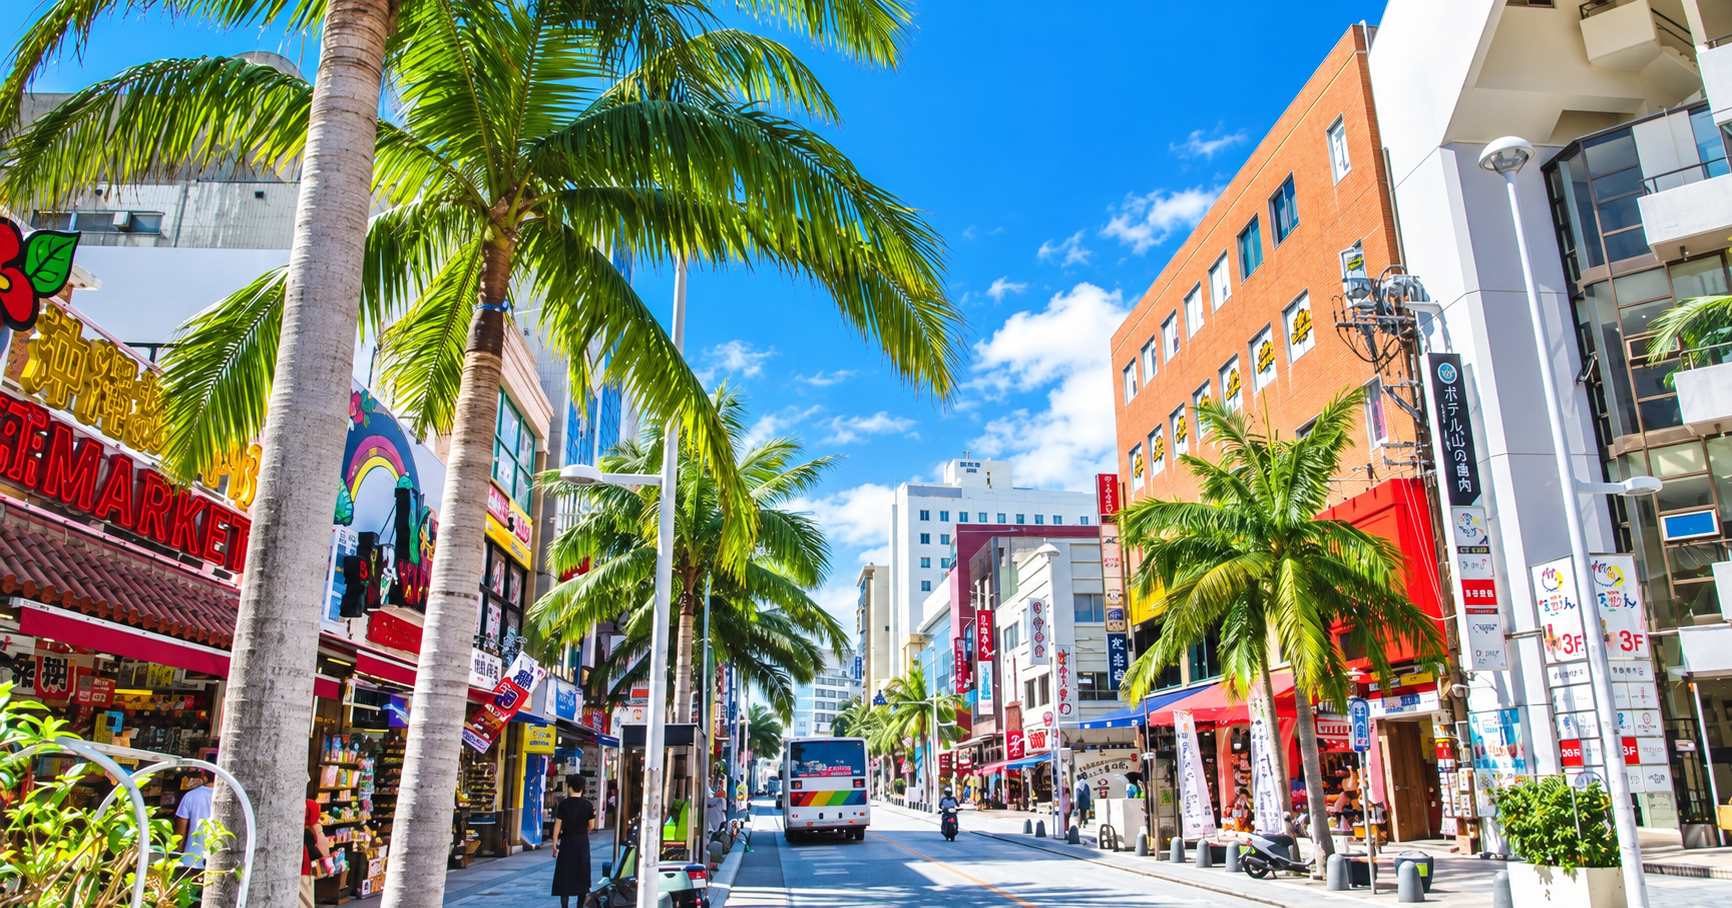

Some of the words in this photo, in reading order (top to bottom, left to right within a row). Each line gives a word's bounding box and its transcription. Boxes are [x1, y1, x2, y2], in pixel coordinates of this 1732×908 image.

[42, 421, 252, 575] MARKET
[1562, 633, 1583, 655] 3F
[1619, 629, 1644, 652] 3F
